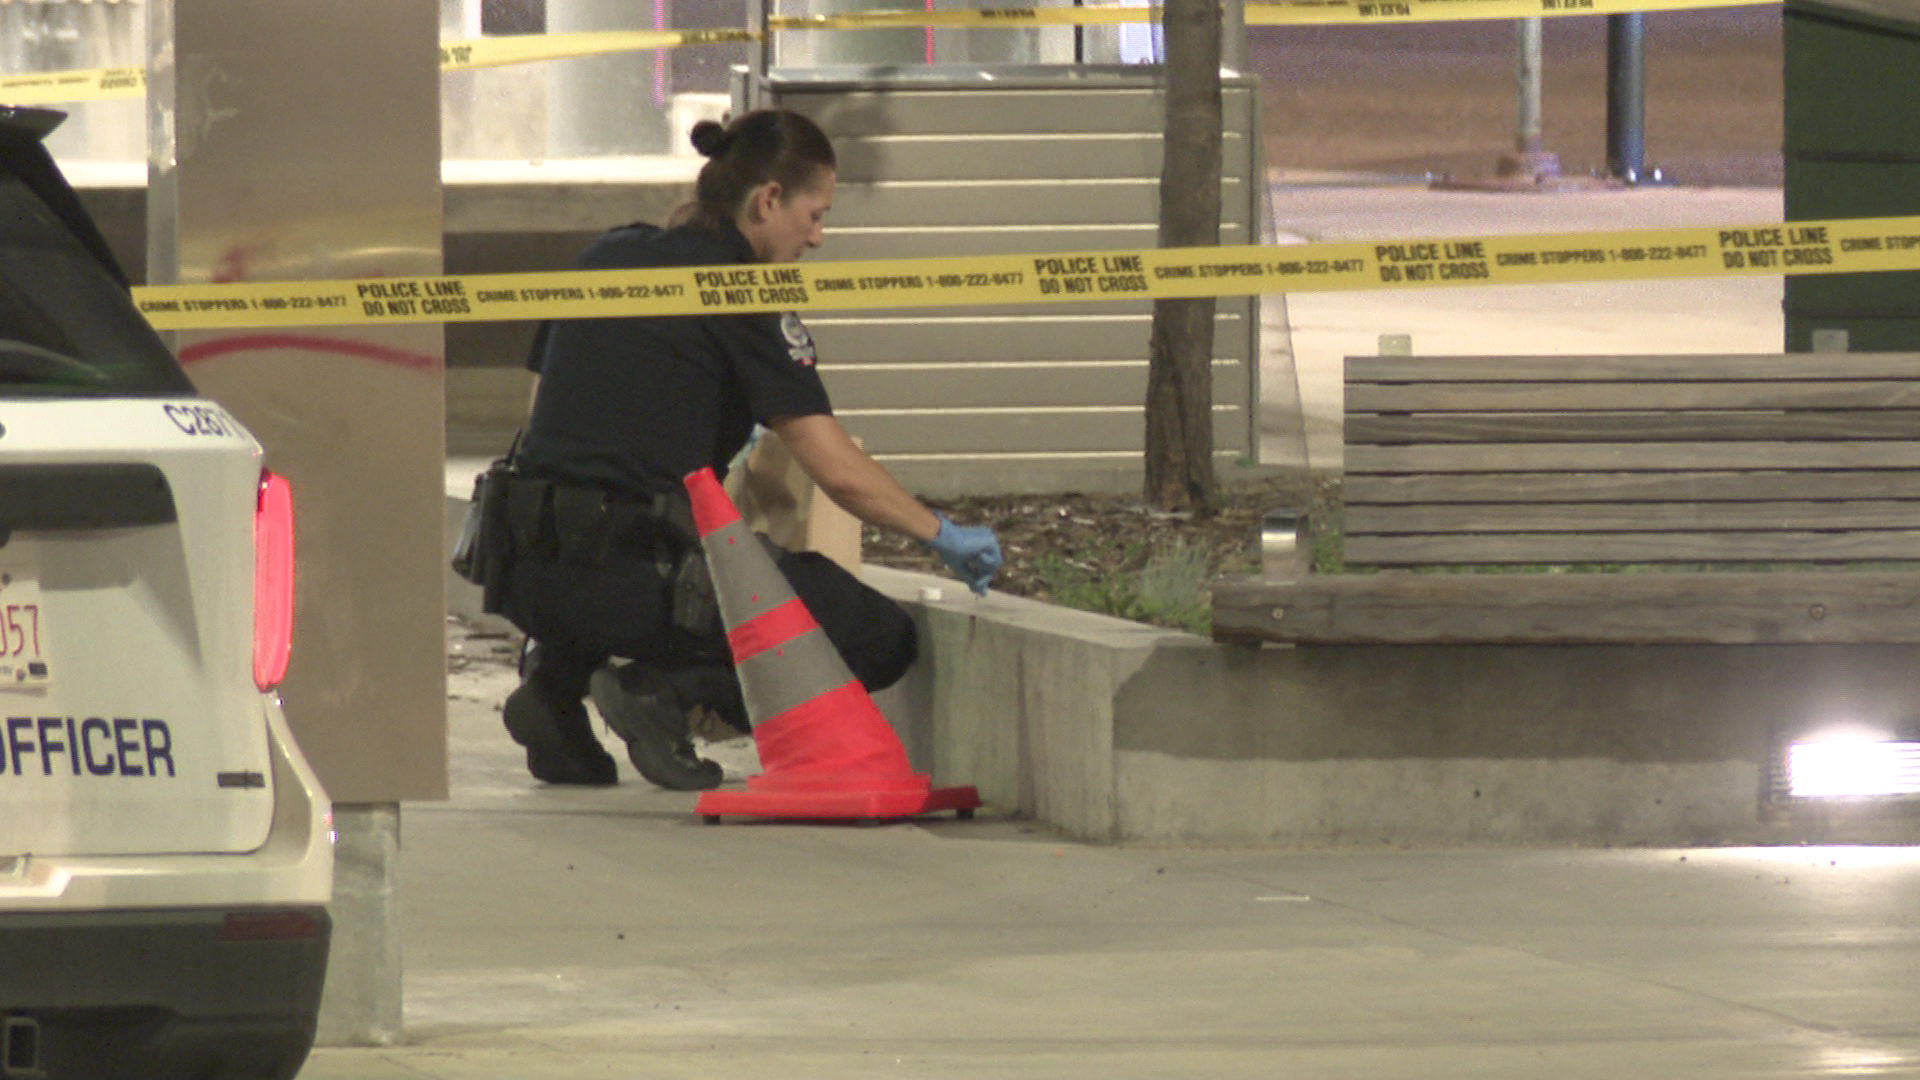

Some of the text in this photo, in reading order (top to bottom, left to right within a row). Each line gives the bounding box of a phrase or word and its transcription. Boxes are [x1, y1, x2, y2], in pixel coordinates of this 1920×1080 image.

[1720, 227, 1830, 248] POLICE LINE
[1841, 238, 1882, 252] CRIME
[1375, 241, 1486, 262] POLICE LINE
[1497, 252, 1538, 266] CRIME
[1540, 249, 1605, 264] STOPPERS
[1723, 248, 1833, 269] DO NOT CROSS
[1034, 255, 1144, 275] POLICE LINE
[1154, 265, 1196, 279] CRIME
[1198, 263, 1263, 278] STOPPERS
[1380, 261, 1489, 282] DO NOT CROSS
[694, 268, 804, 288] POLICE LINE
[815, 278, 856, 292] CRIME
[858, 275, 923, 290] STOPPERS
[1039, 275, 1149, 294] DO NOT CROSS
[357, 280, 466, 299] POLICE LINE
[476, 289, 518, 303] CRIME
[520, 287, 585, 302] STOPPERS
[700, 286, 809, 306] DO NOT CROSS
[140, 300, 181, 312] CRIME
[184, 298, 248, 311] STOPPERS
[363, 298, 471, 316] DO NOT CROSS
[0, 717, 175, 777] FFICER
